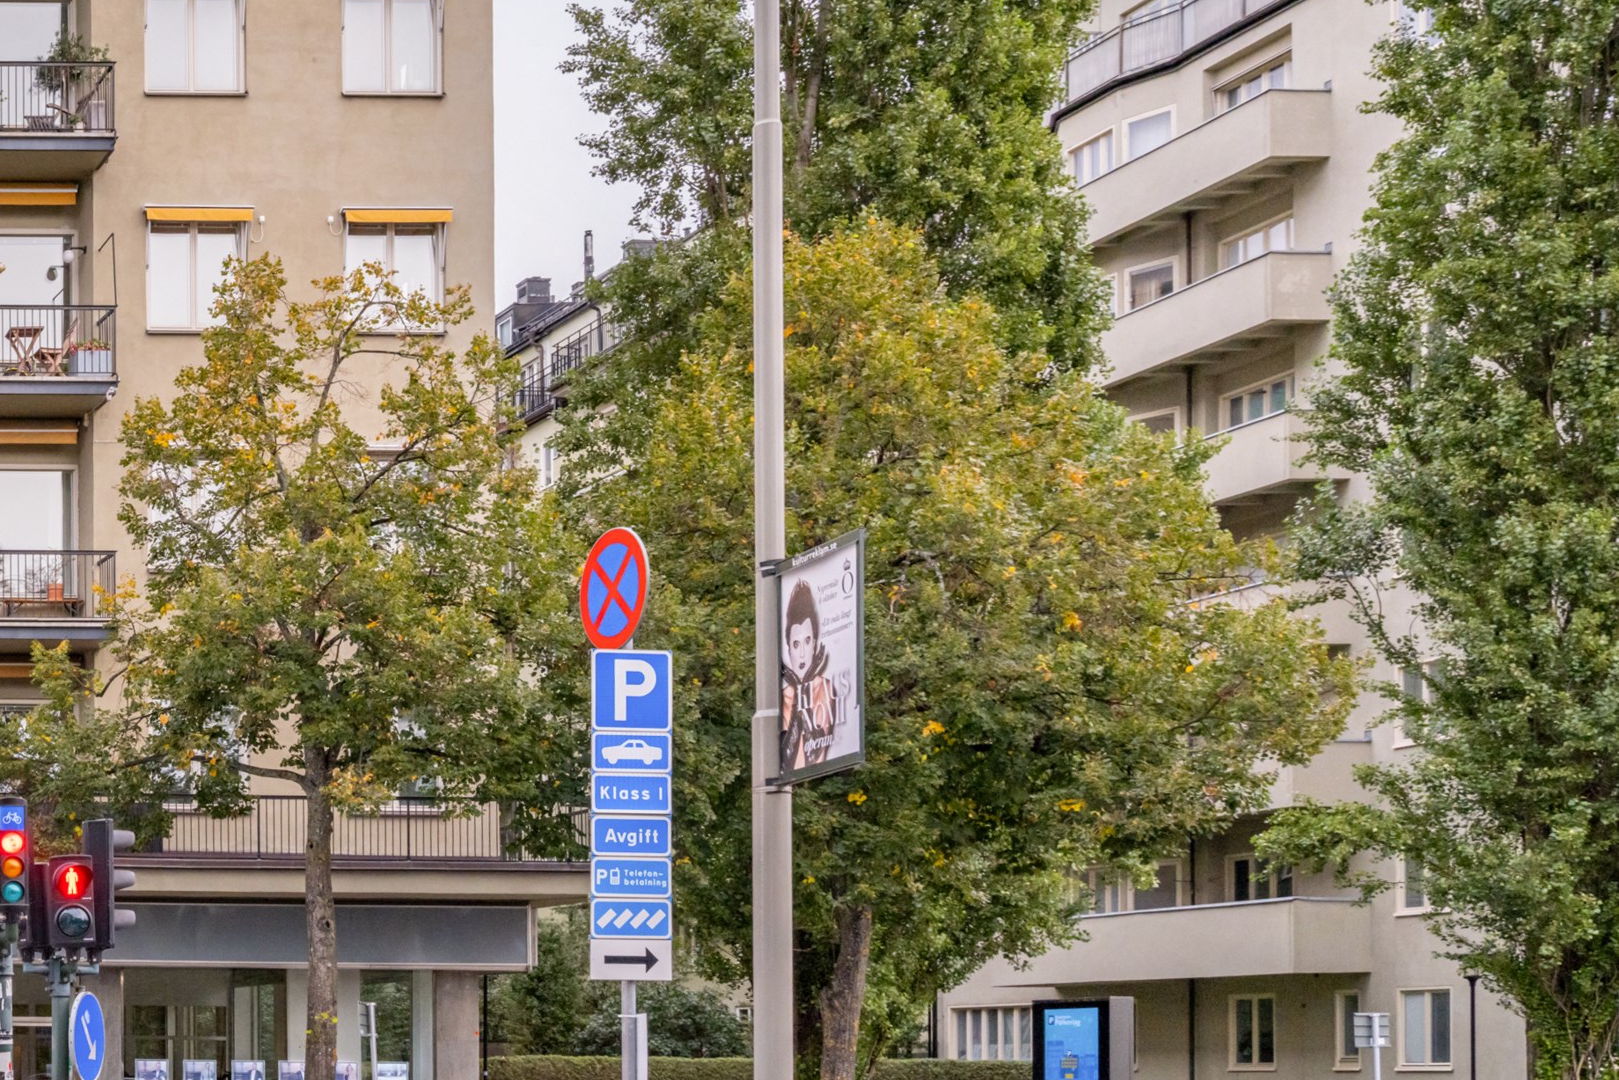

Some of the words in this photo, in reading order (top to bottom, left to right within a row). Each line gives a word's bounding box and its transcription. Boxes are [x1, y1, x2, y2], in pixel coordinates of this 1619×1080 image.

[614, 658, 657, 722] P
[600, 785, 650, 801] Klass
[604, 827, 659, 847] Avgift
[596, 868, 608, 885] P
[624, 869, 664, 878] Telefon-
[623, 878, 667, 888] betalning
